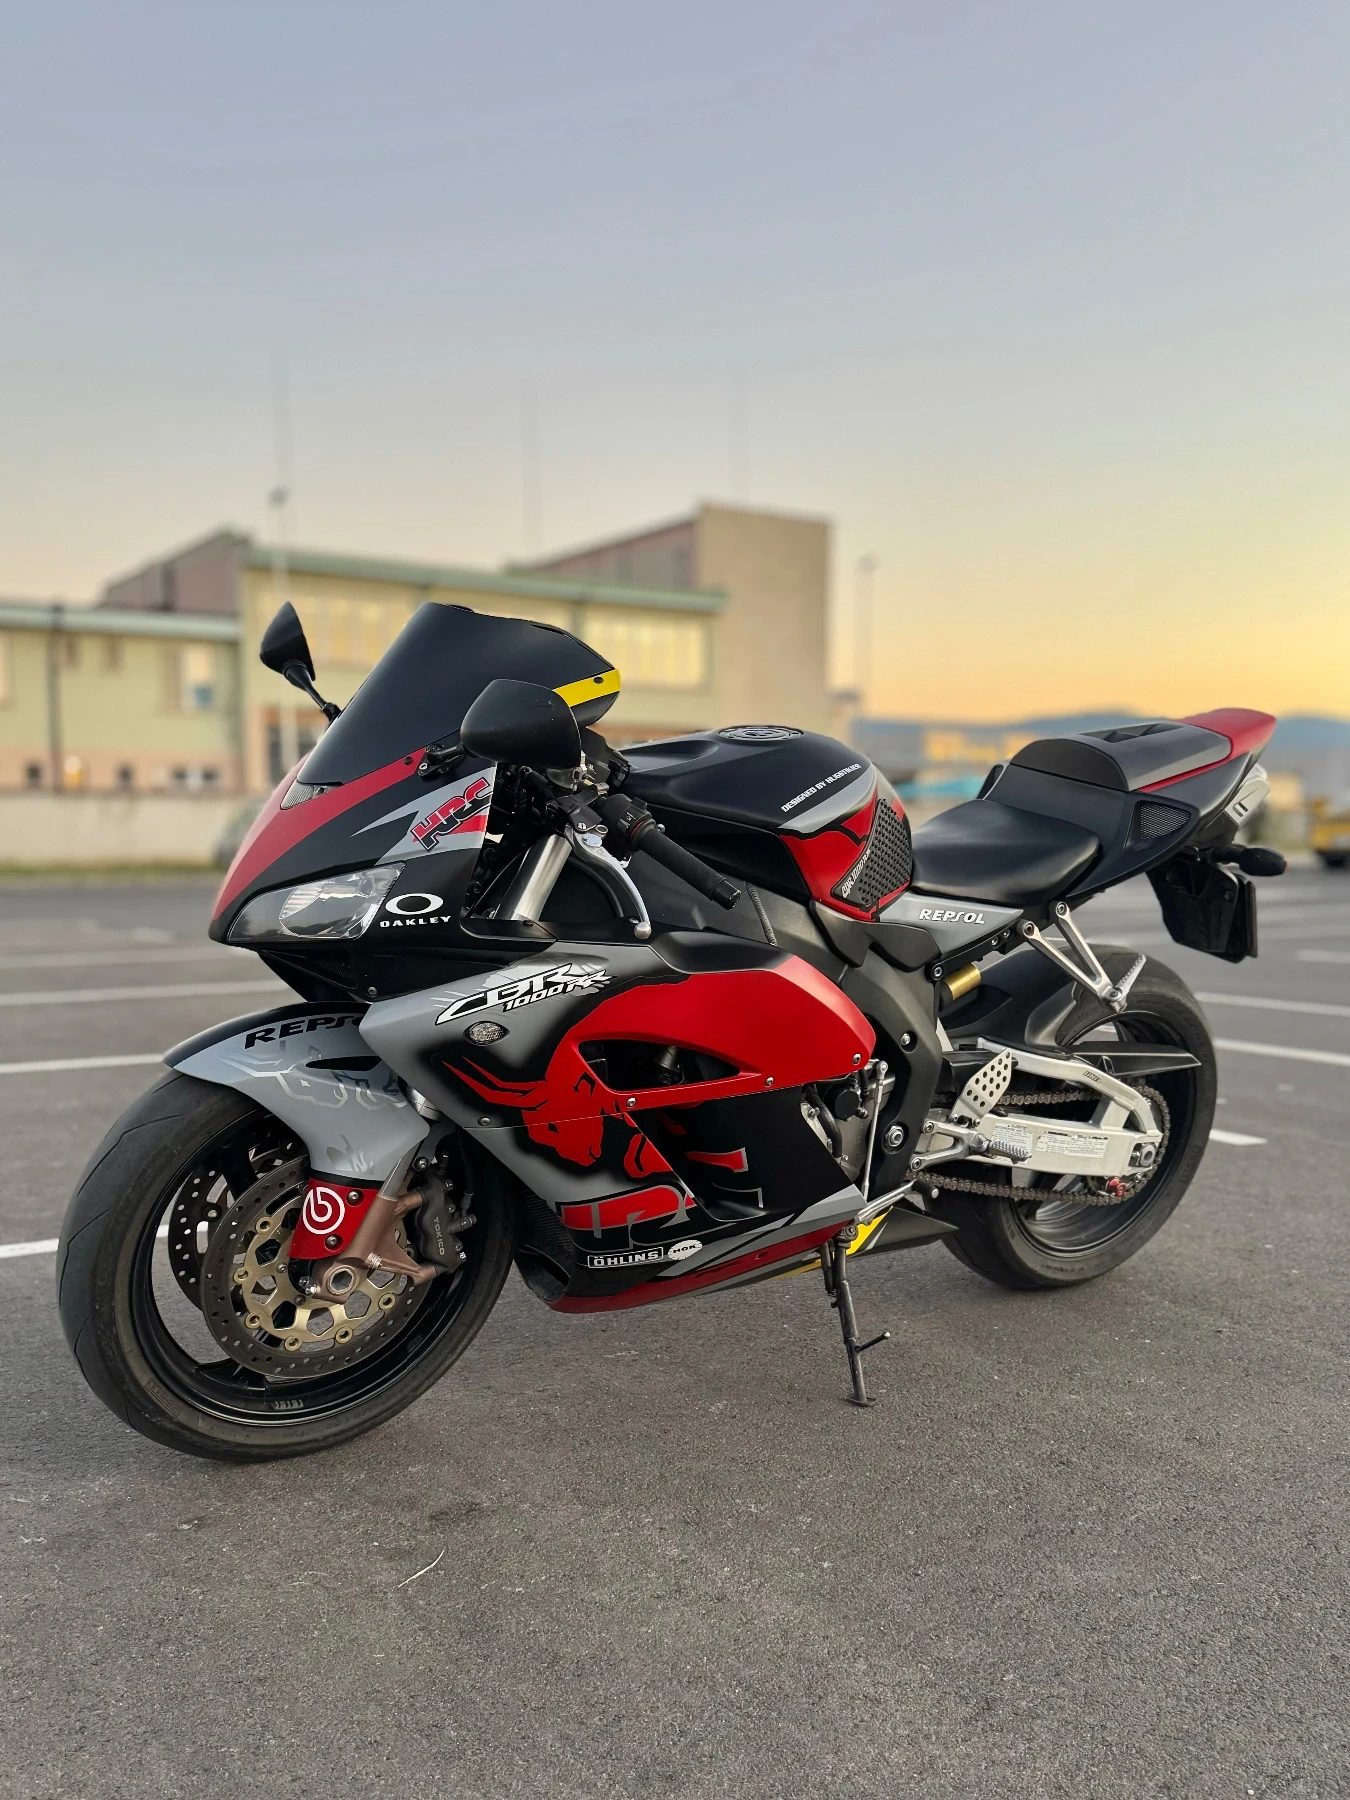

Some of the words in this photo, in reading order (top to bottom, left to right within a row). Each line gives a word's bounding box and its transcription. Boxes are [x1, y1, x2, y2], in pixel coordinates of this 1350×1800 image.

[781, 787, 817, 812] DESIGNED
[815, 781, 827, 790] BY
[410, 777, 493, 852] HRC
[379, 915, 452, 928] OAKLEY
[918, 908, 985, 925] REPSOL
[435, 963, 573, 1026] CBR
[433, 1216, 445, 1256] TOKICO
[593, 1250, 659, 1267] ÖHLINS
